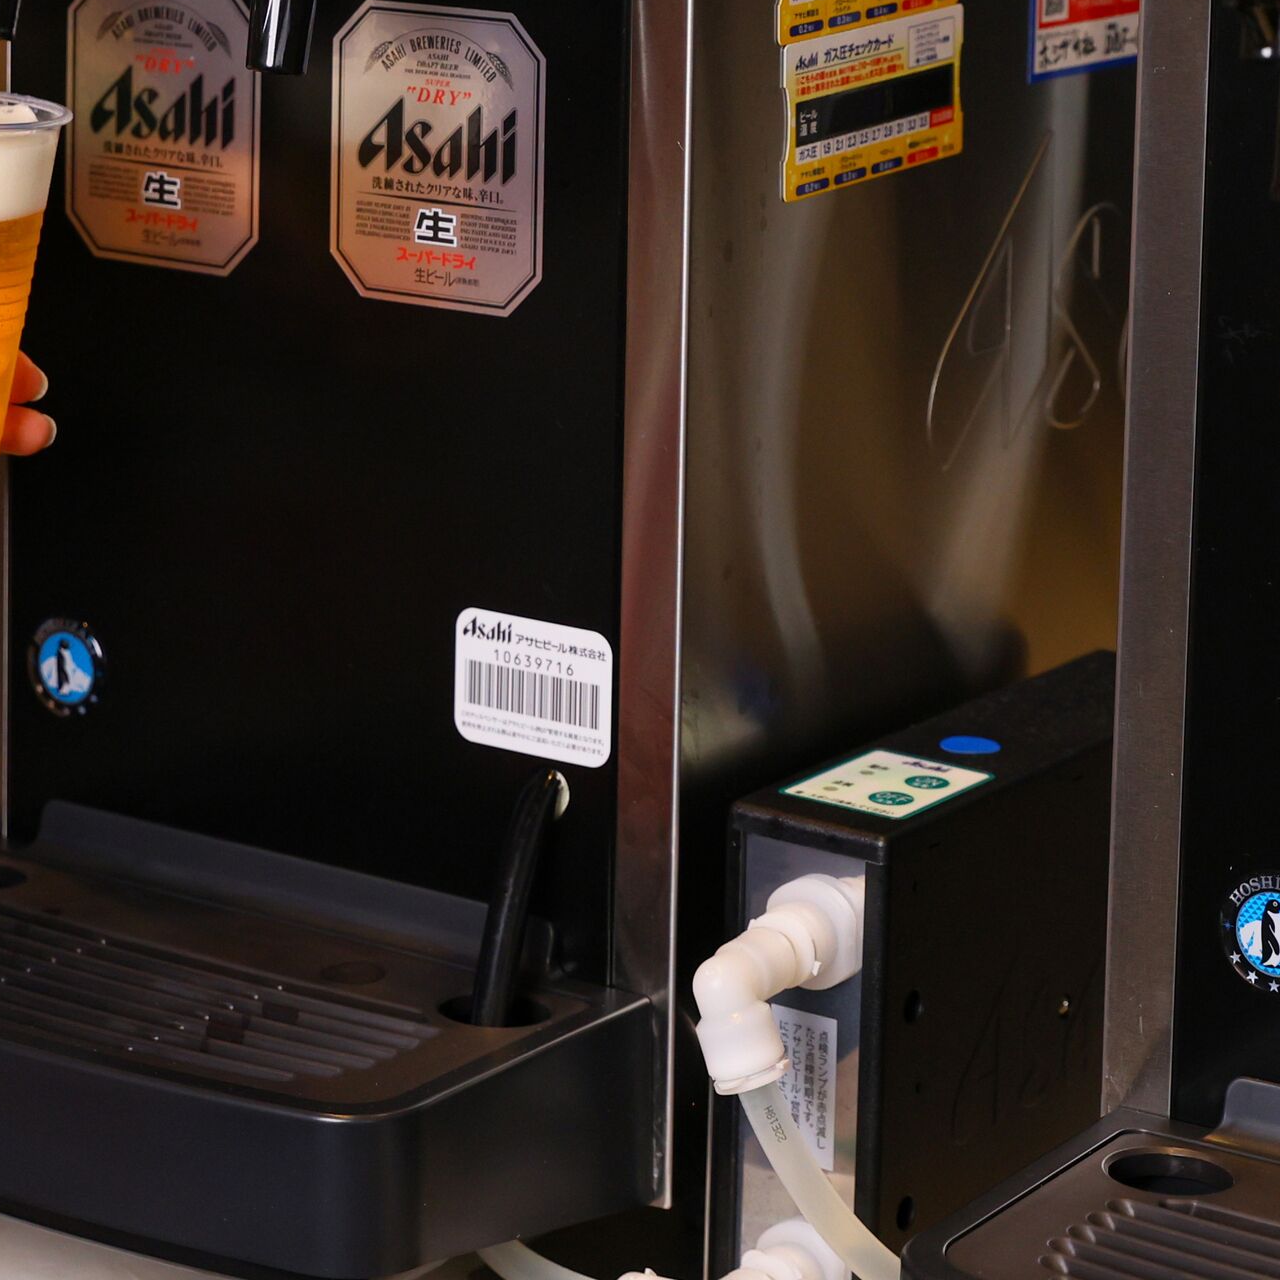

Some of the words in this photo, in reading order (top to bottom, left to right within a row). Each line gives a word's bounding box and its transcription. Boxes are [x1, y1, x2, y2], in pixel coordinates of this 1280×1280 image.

[381, 43, 408, 72] ASAHI
[409, 35, 462, 55] BREWERIES
[464, 47, 497, 84] LIMITED
[427, 53, 449, 61] ASAHI
[425, 78, 451, 88] SUPER
[90, 65, 236, 152] Asahi
[357, 96, 519, 187] Asahi
[144, 172, 181, 210] 生
[414, 208, 457, 247] 生
[396, 247, 478, 271] スーパードライ
[463, 616, 512, 645] Asahi
[493, 648, 575, 677] 10639716
